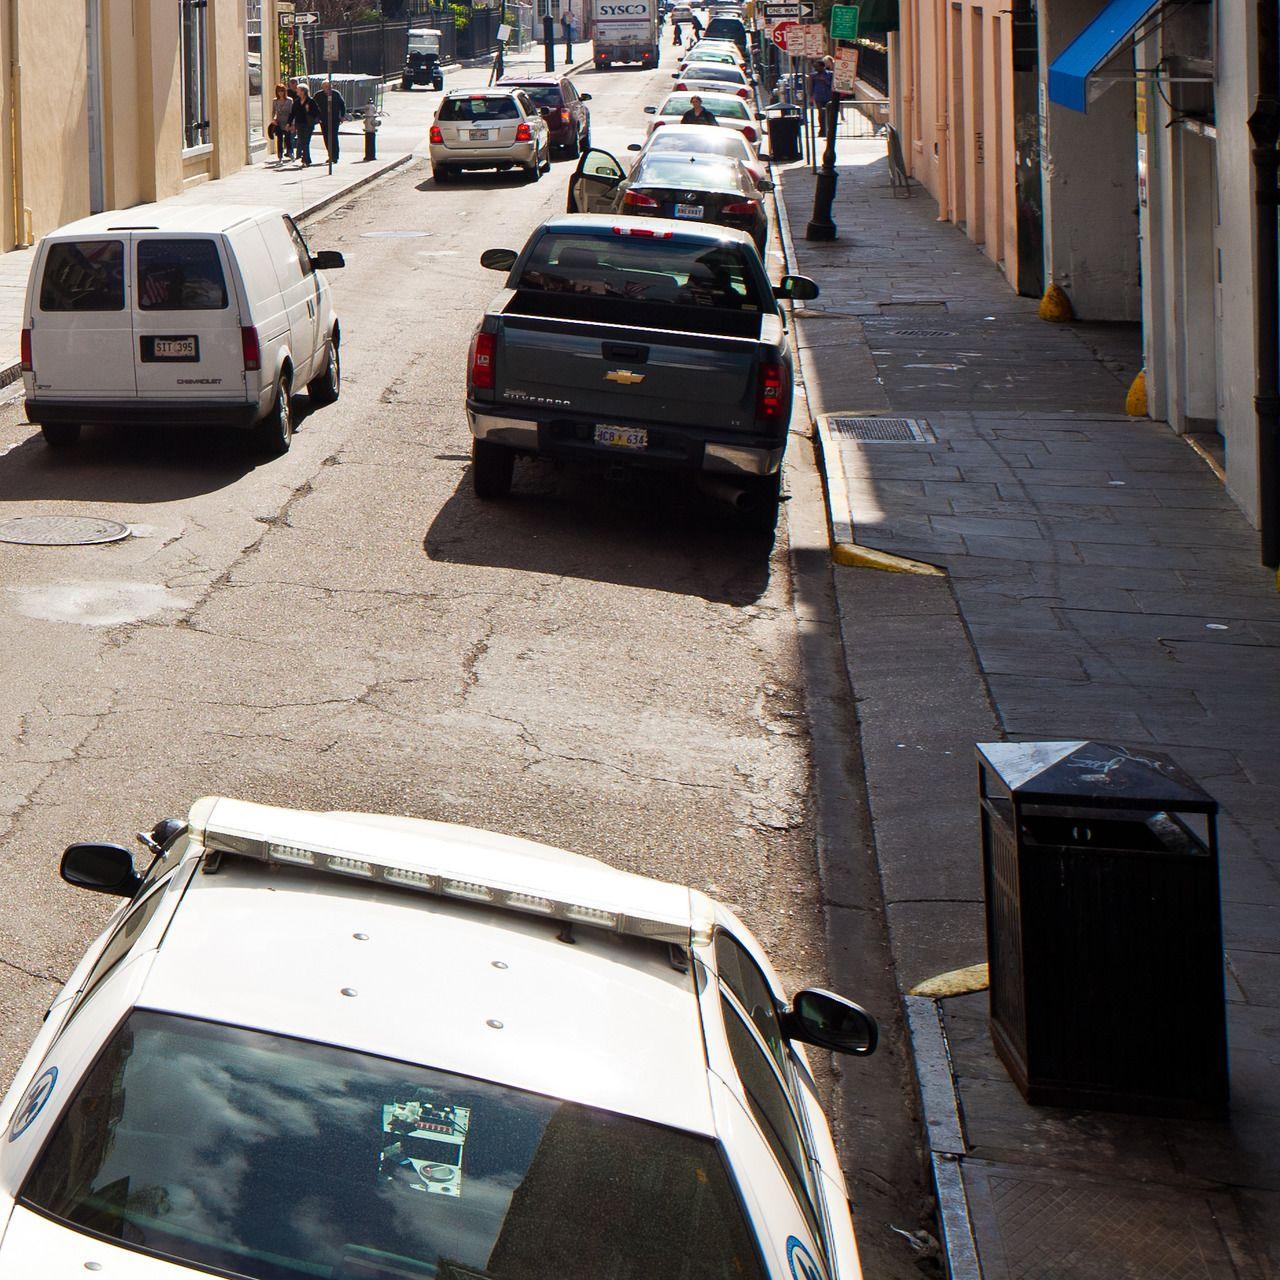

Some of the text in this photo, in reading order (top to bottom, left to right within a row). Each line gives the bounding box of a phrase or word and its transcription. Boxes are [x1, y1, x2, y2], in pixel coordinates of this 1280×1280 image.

[600, 5, 646, 15] SYSCO
[775, 31, 787, 42] ST
[157, 342, 193, 352] SIT 395
